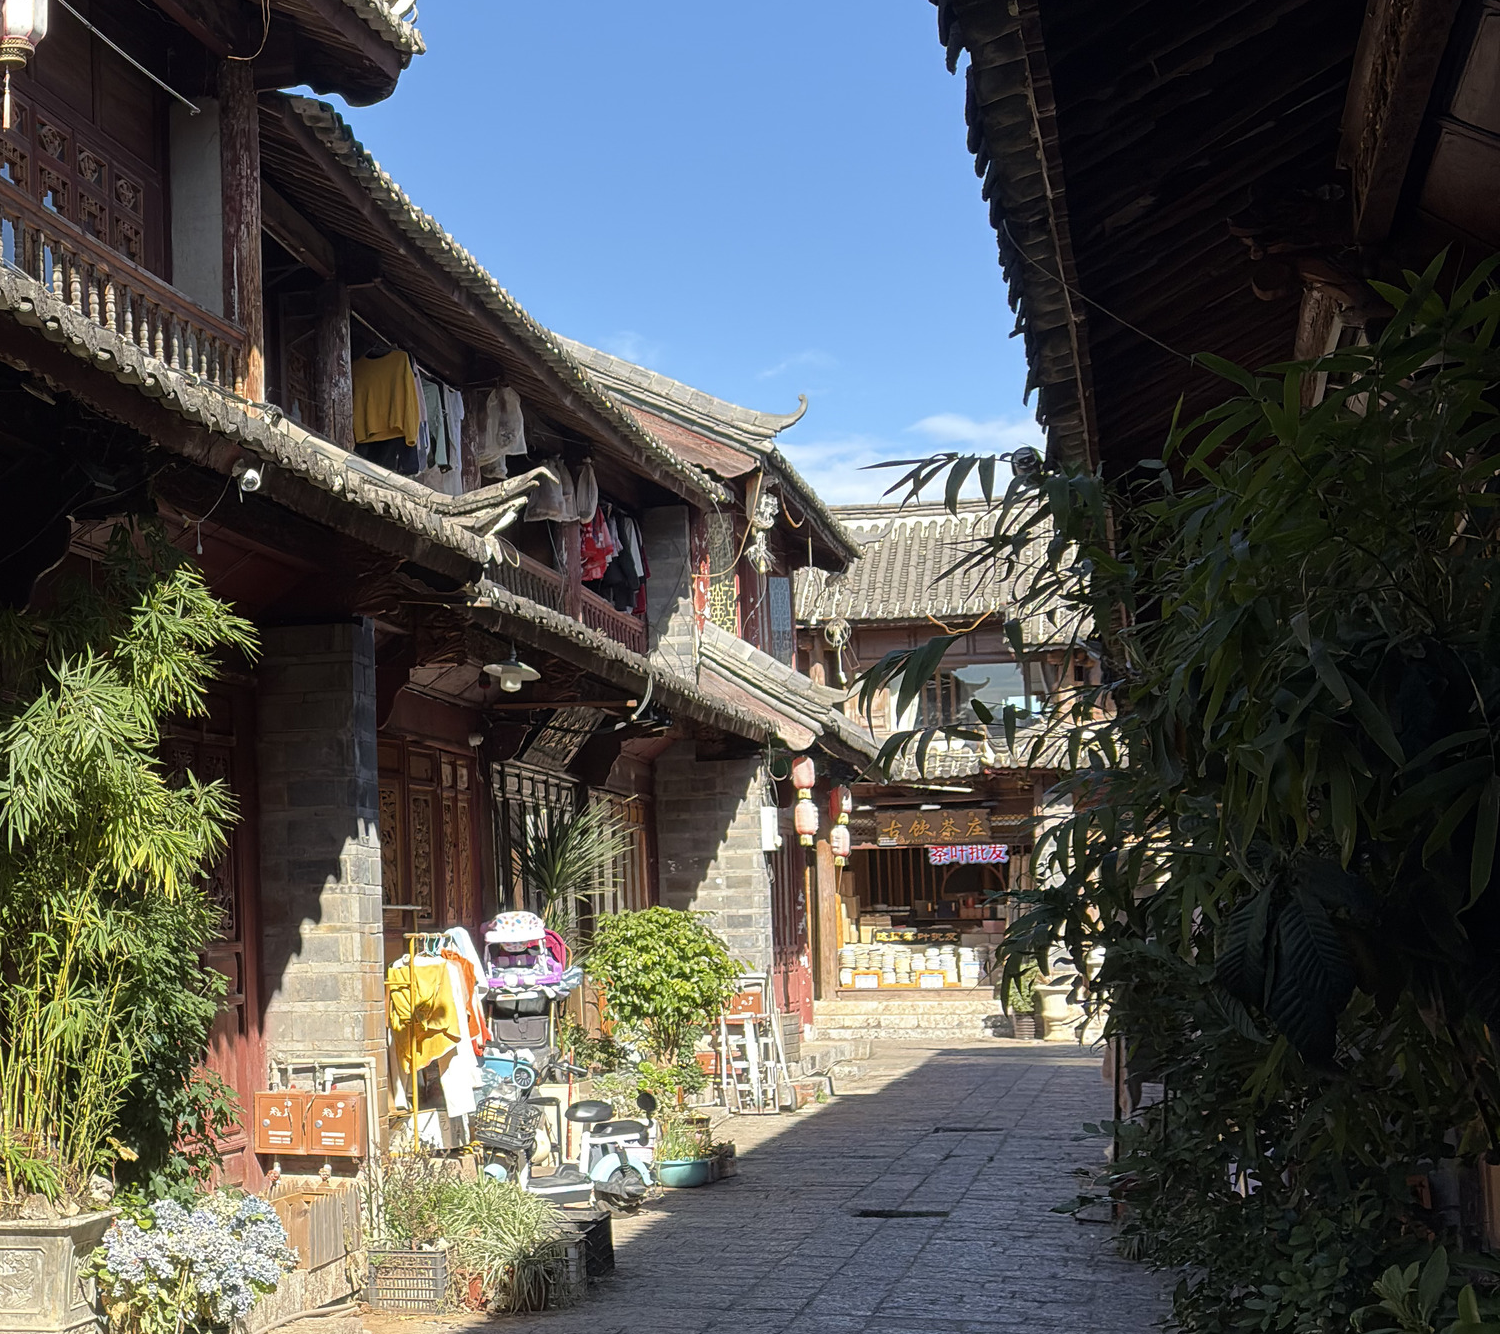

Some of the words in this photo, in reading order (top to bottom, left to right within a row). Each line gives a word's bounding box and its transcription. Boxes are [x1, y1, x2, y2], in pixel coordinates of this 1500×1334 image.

[882, 818, 987, 839] 古饮茶庄
[930, 844, 1006, 864] 茶叶批发
